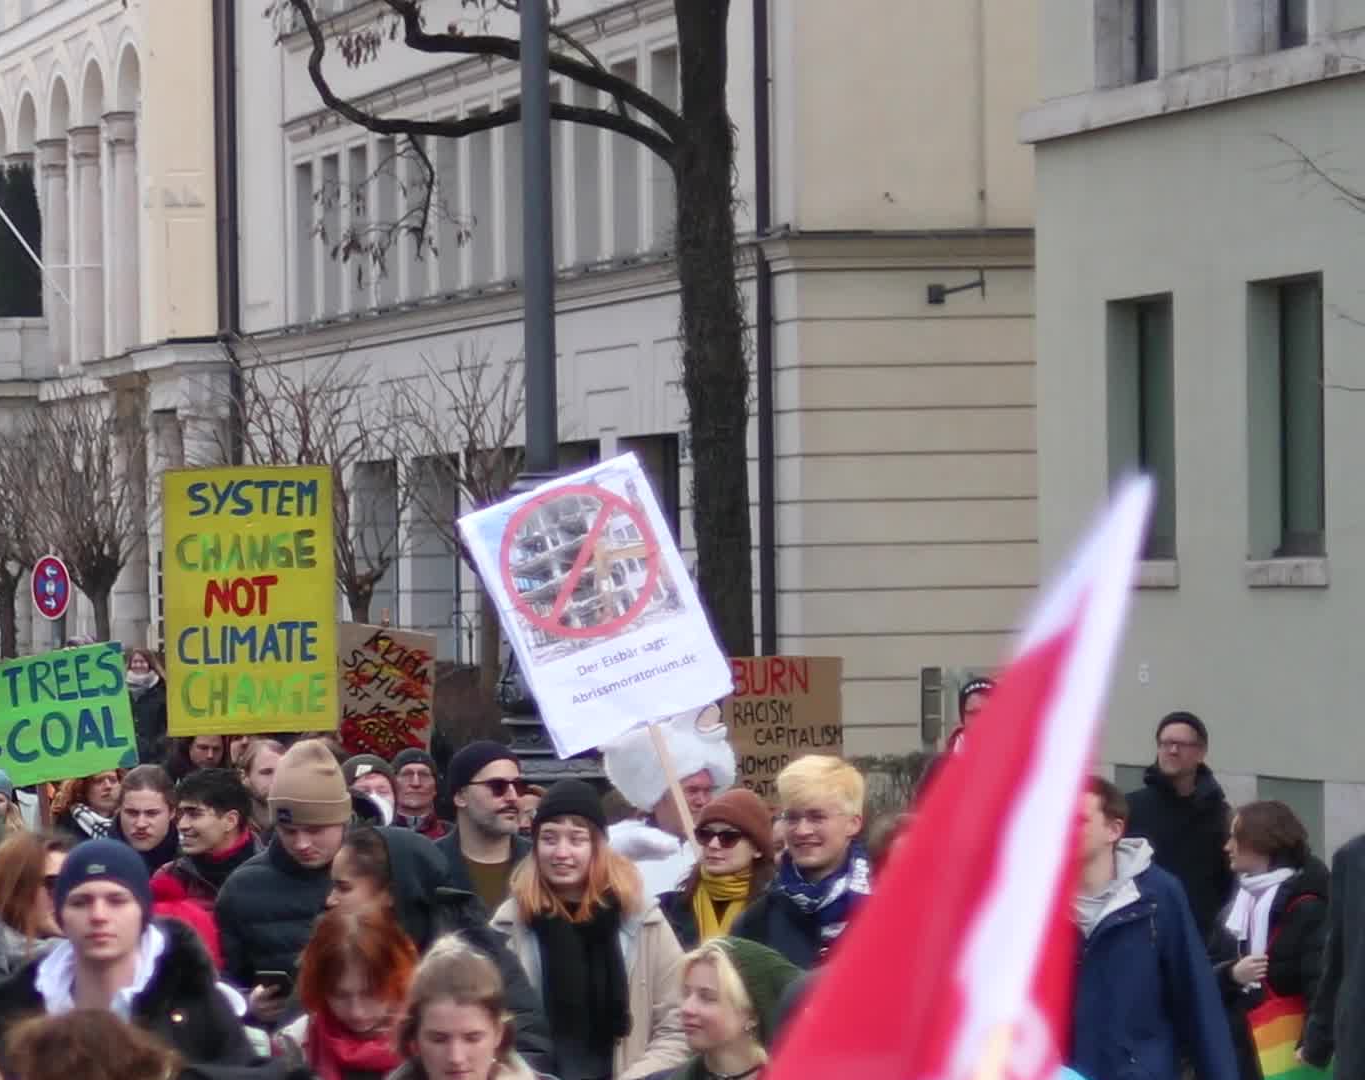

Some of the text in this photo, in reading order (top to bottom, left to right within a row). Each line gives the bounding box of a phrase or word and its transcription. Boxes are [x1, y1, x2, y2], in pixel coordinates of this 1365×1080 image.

[187, 480, 318, 517] SYSTEM
[176, 529, 317, 572] CHANGE
[204, 576, 278, 619] NOT
[178, 621, 318, 665] CLIMATE
[575, 661, 599, 677] Der
[601, 646, 638, 667] Eisbär
[181, 672, 326, 718] CHANGE
[572, 653, 697, 705] Abrissmoratorium.de
[731, 658, 810, 697] BURN
[733, 701, 793, 728] RACISM
[754, 724, 843, 747] CAPITALISM
